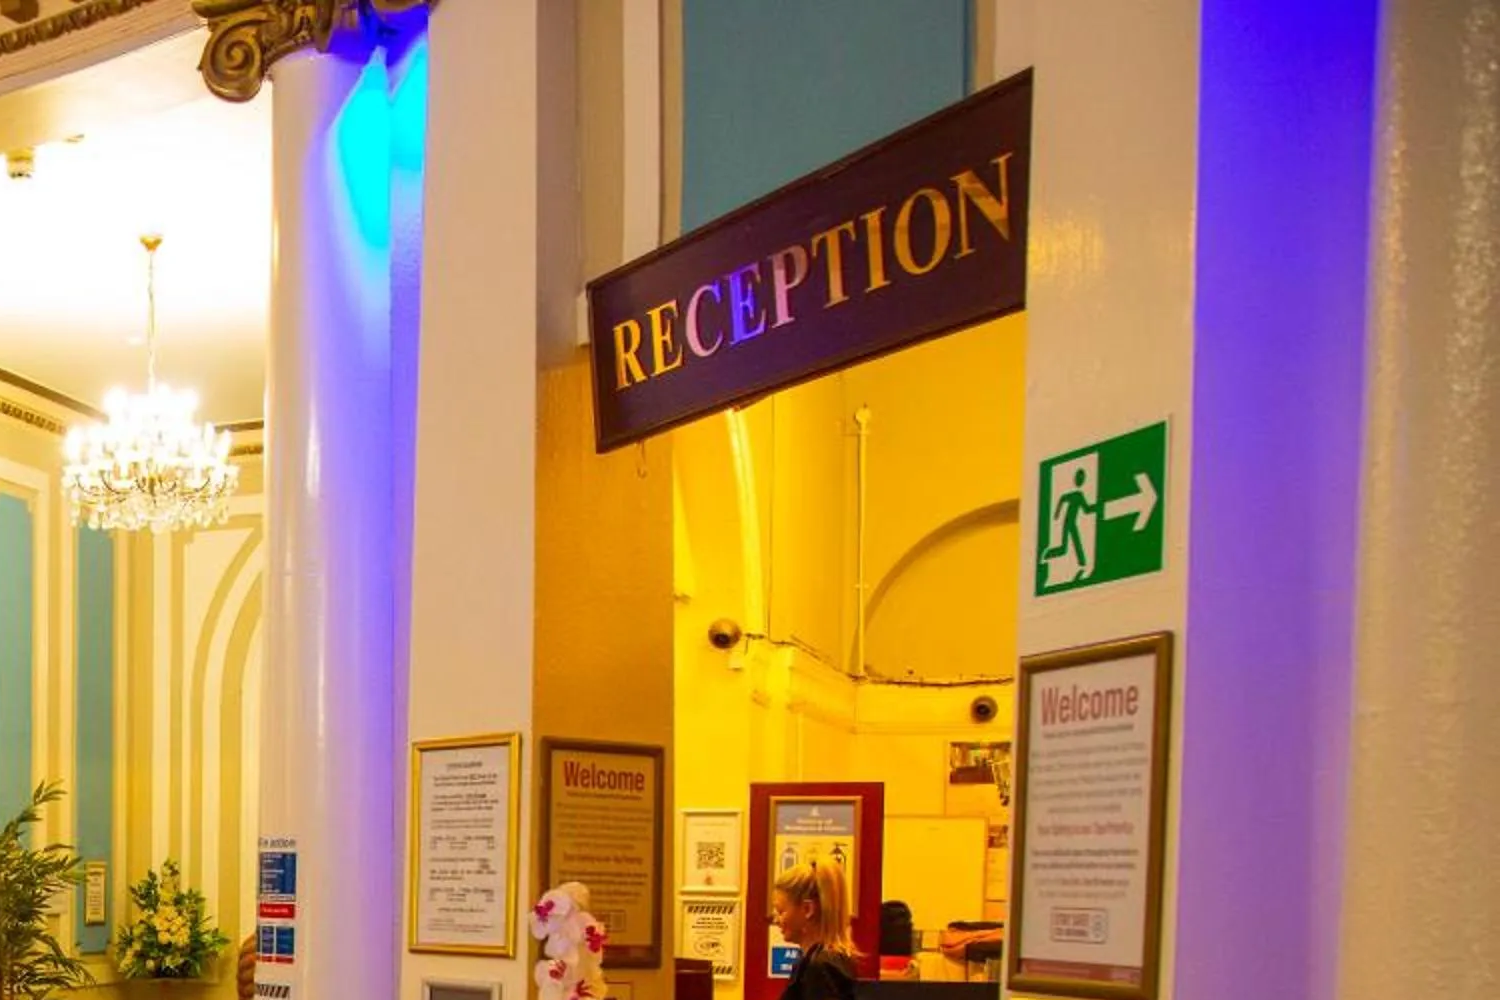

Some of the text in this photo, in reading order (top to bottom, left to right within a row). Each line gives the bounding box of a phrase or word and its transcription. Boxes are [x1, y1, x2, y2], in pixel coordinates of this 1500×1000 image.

[612, 152, 1013, 391] RECEPTION
[1040, 684, 1139, 725] Welcome
[563, 760, 645, 791] Welcome
